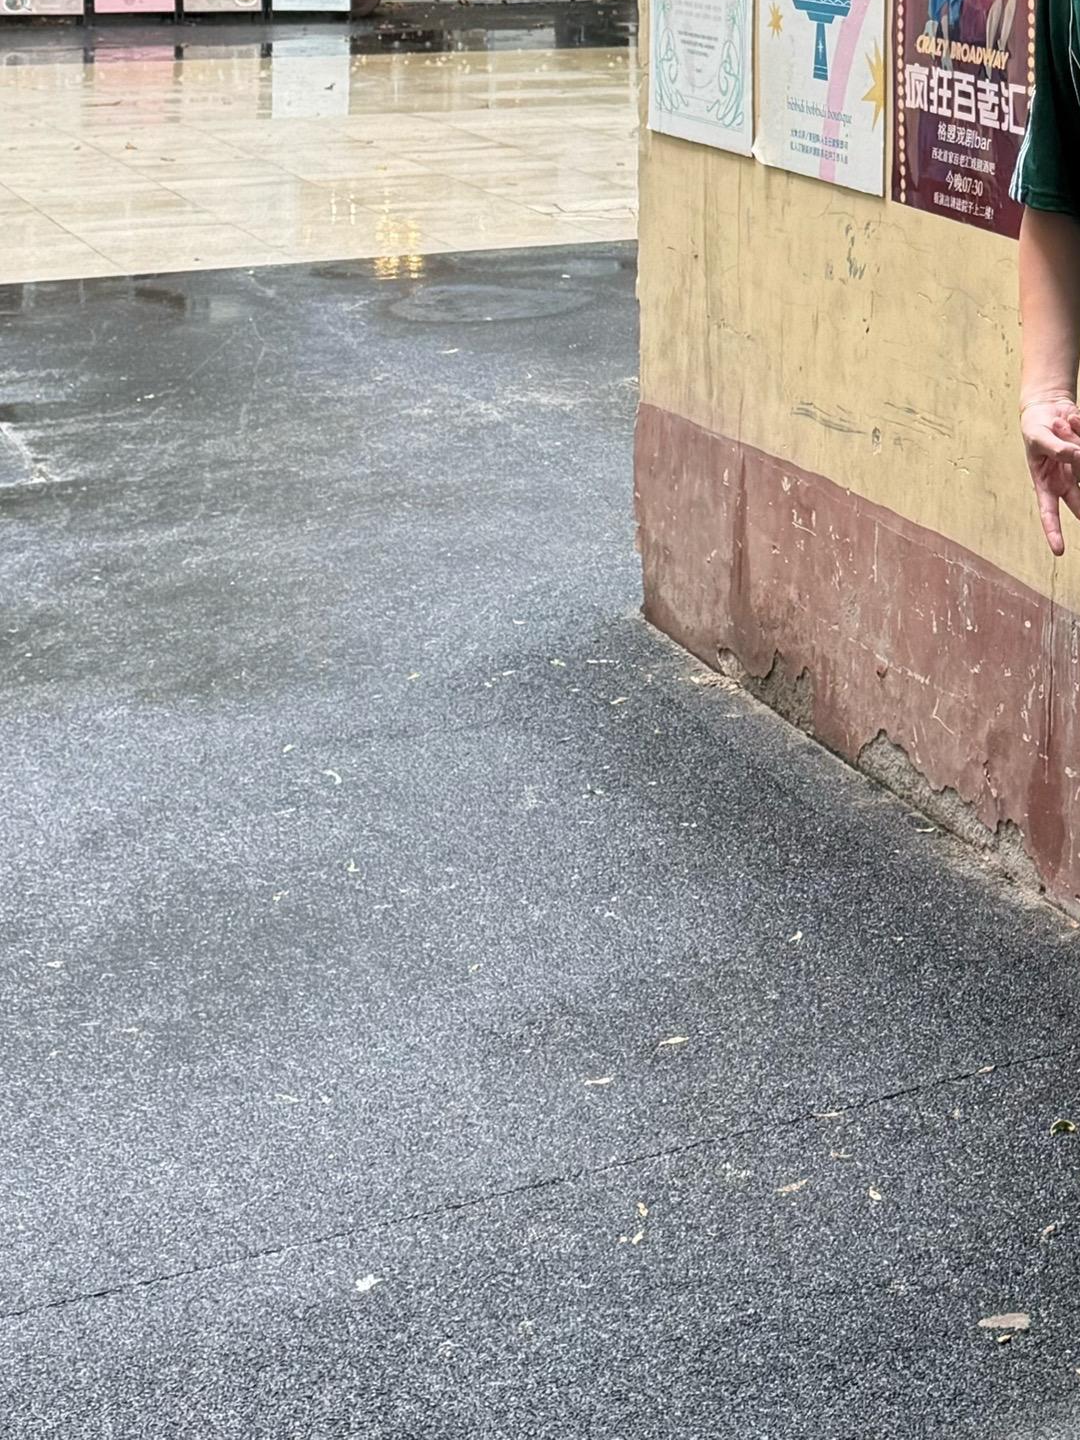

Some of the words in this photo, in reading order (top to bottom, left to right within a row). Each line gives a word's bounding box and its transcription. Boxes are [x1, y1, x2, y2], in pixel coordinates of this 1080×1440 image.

[916, 35, 945, 57] CRAZY
[950, 41, 1009, 70] BROADWAY
[905, 63, 1026, 136] 疯狂百老汇
